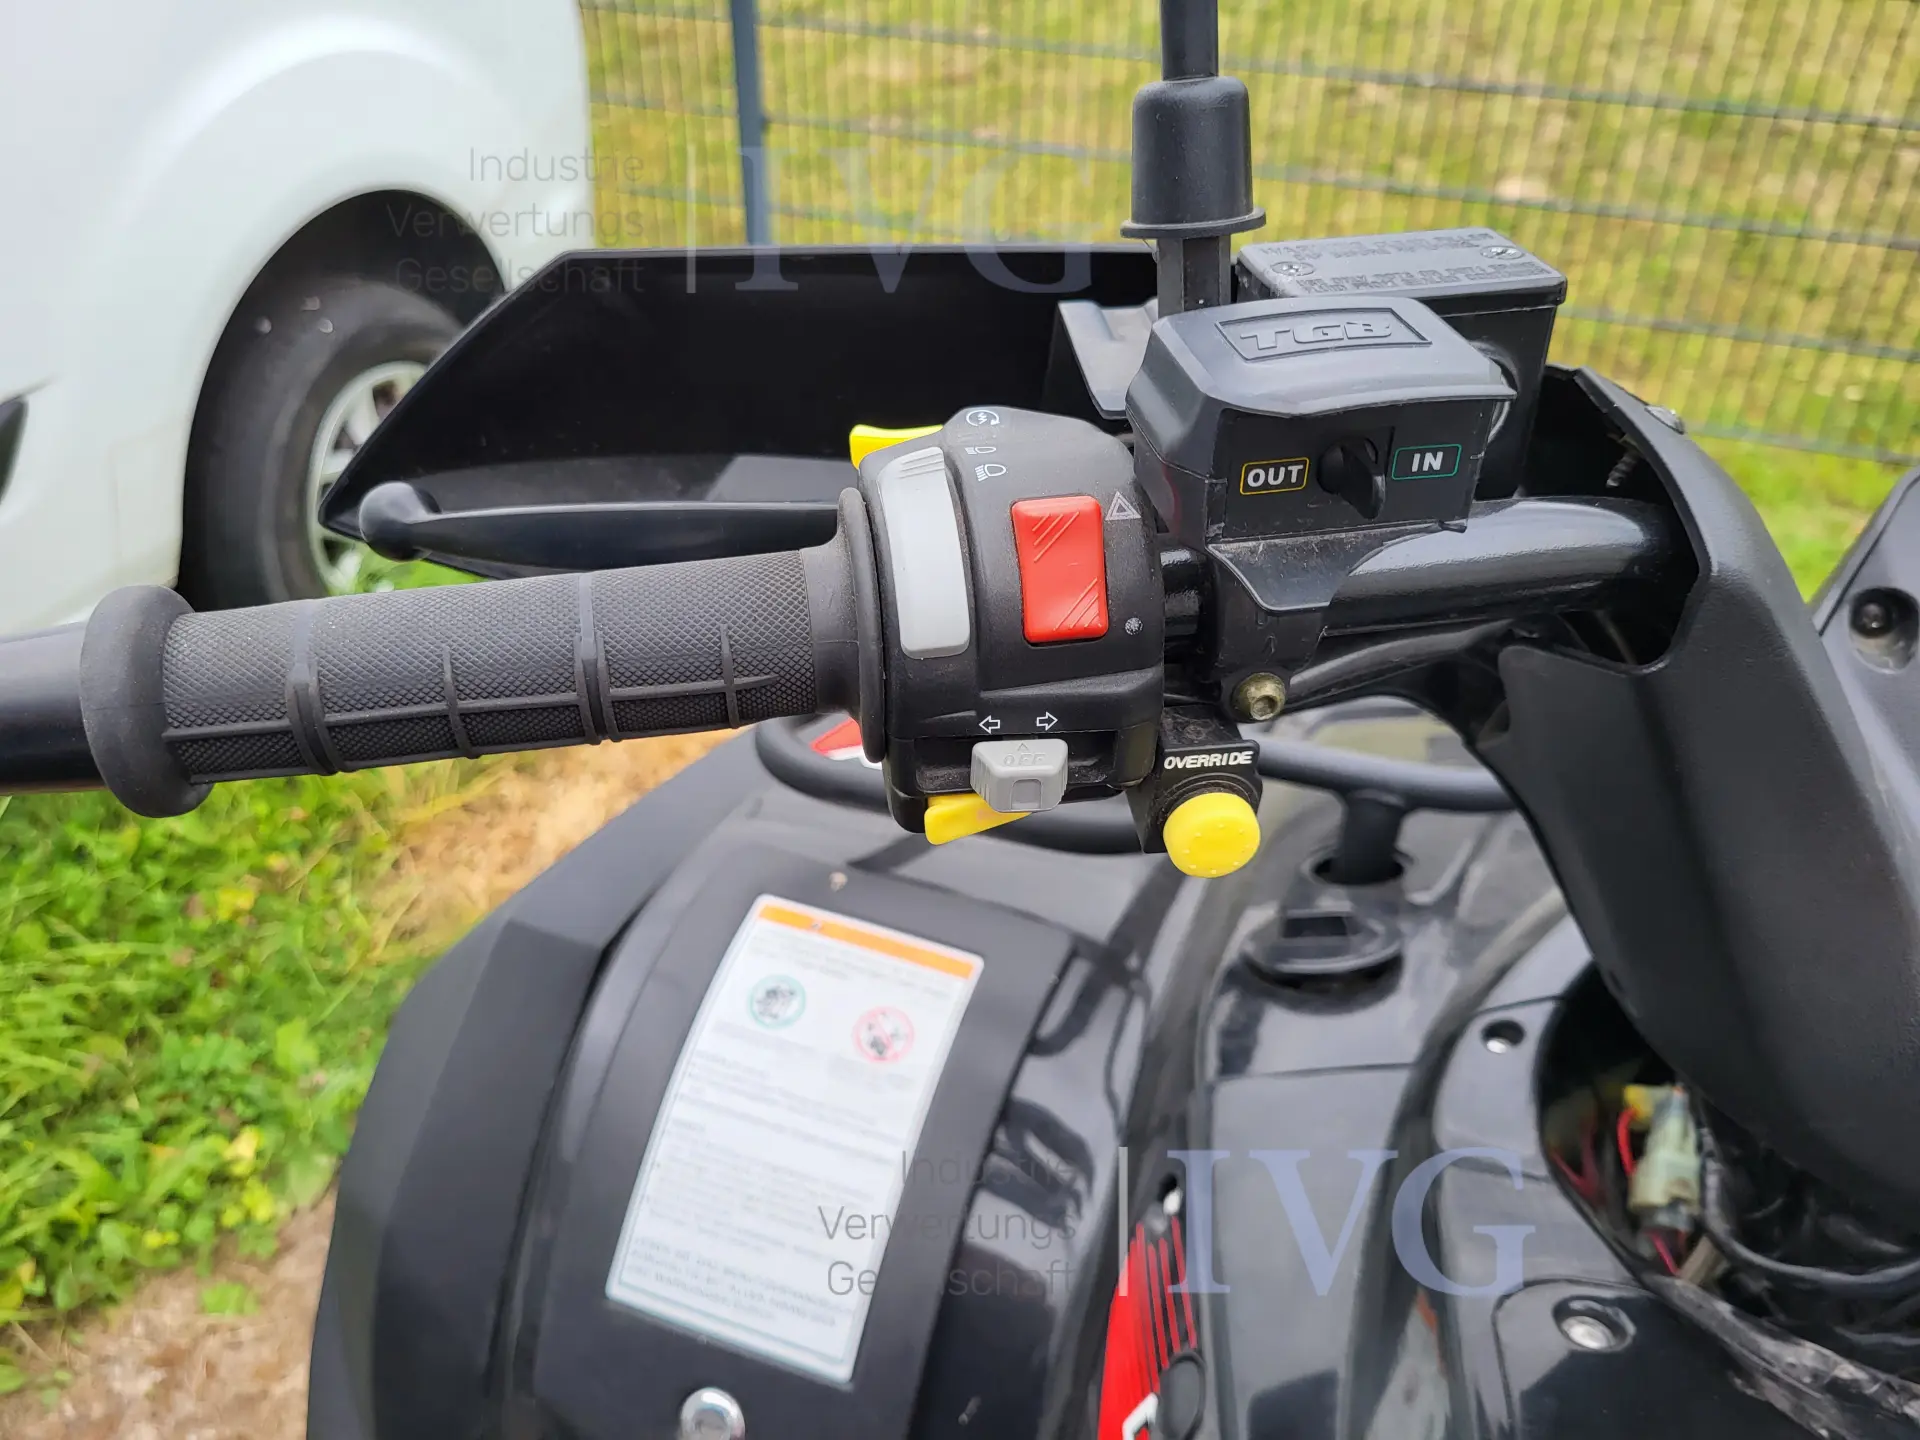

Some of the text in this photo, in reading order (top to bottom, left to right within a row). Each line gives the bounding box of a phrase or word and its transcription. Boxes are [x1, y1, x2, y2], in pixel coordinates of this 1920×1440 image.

[1239, 318, 1392, 351] TGB
[1410, 450, 1445, 474] IN
[1246, 463, 1304, 489] OUT
[1003, 752, 1048, 768] OFF
[1162, 749, 1255, 771] OVERRIDE
